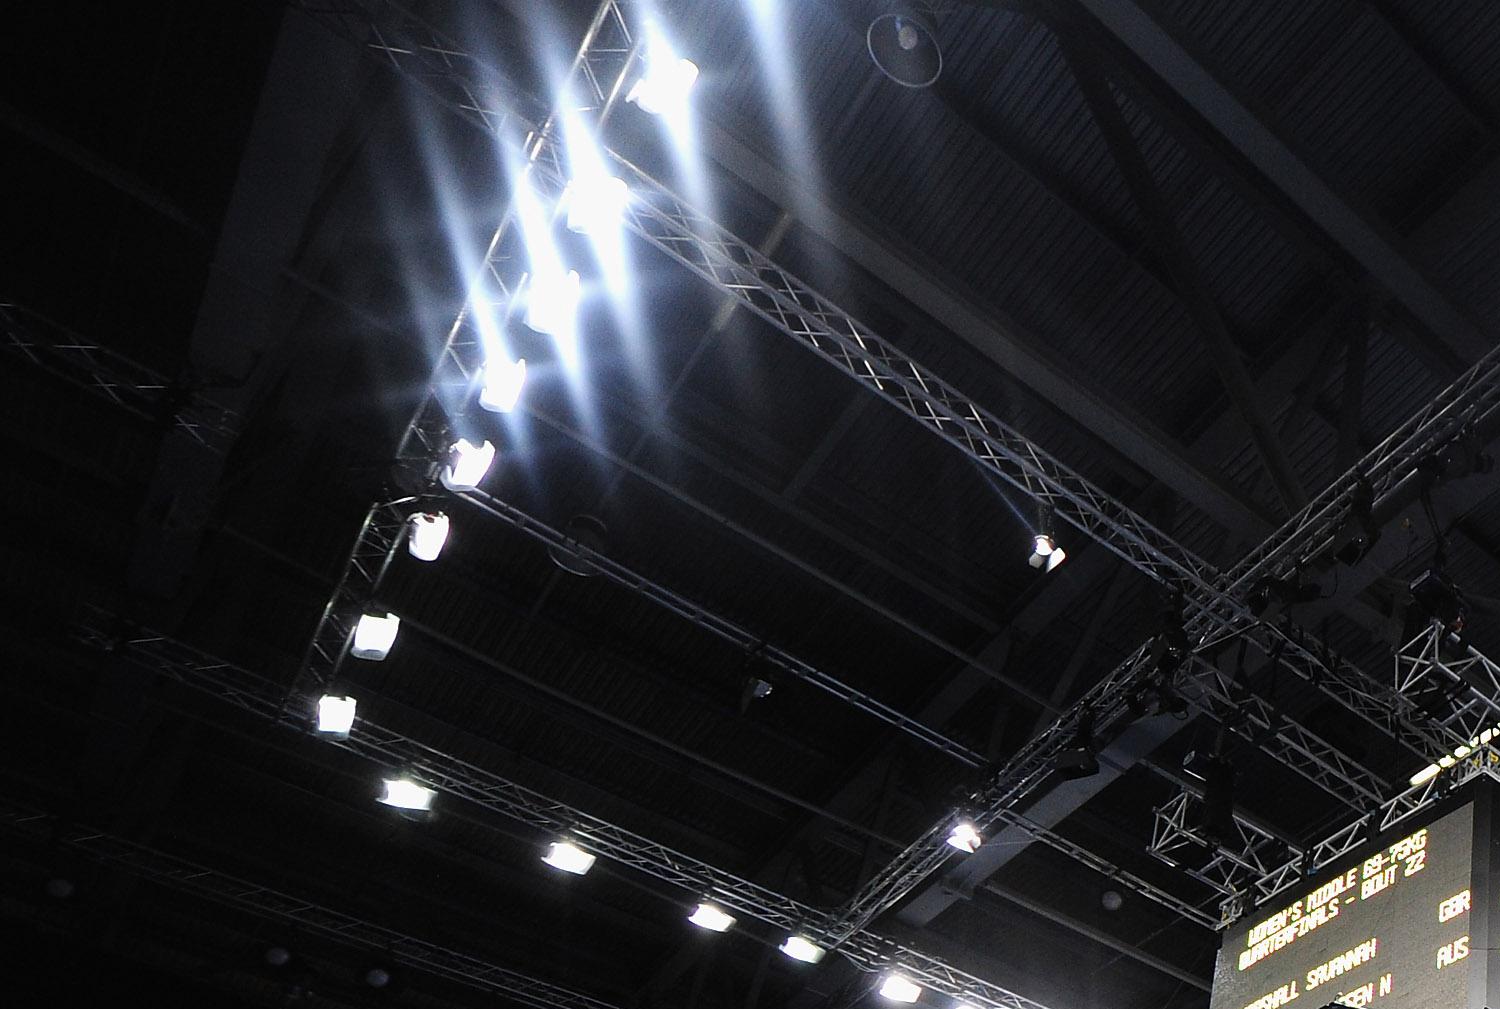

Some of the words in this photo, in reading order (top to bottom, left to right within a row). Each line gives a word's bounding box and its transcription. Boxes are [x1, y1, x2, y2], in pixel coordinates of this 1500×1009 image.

[1238, 898, 1339, 971] QUARTERFINALS
[1361, 864, 1398, 900] BOUT
[1405, 850, 1426, 877] 22
[1247, 901, 1303, 947] WOMEN'S
[1306, 868, 1357, 912] MIDDLE
[1306, 938, 1376, 991] SAVANNAH
[1439, 889, 1471, 923] GBR
[1437, 936, 1469, 969] AUS
